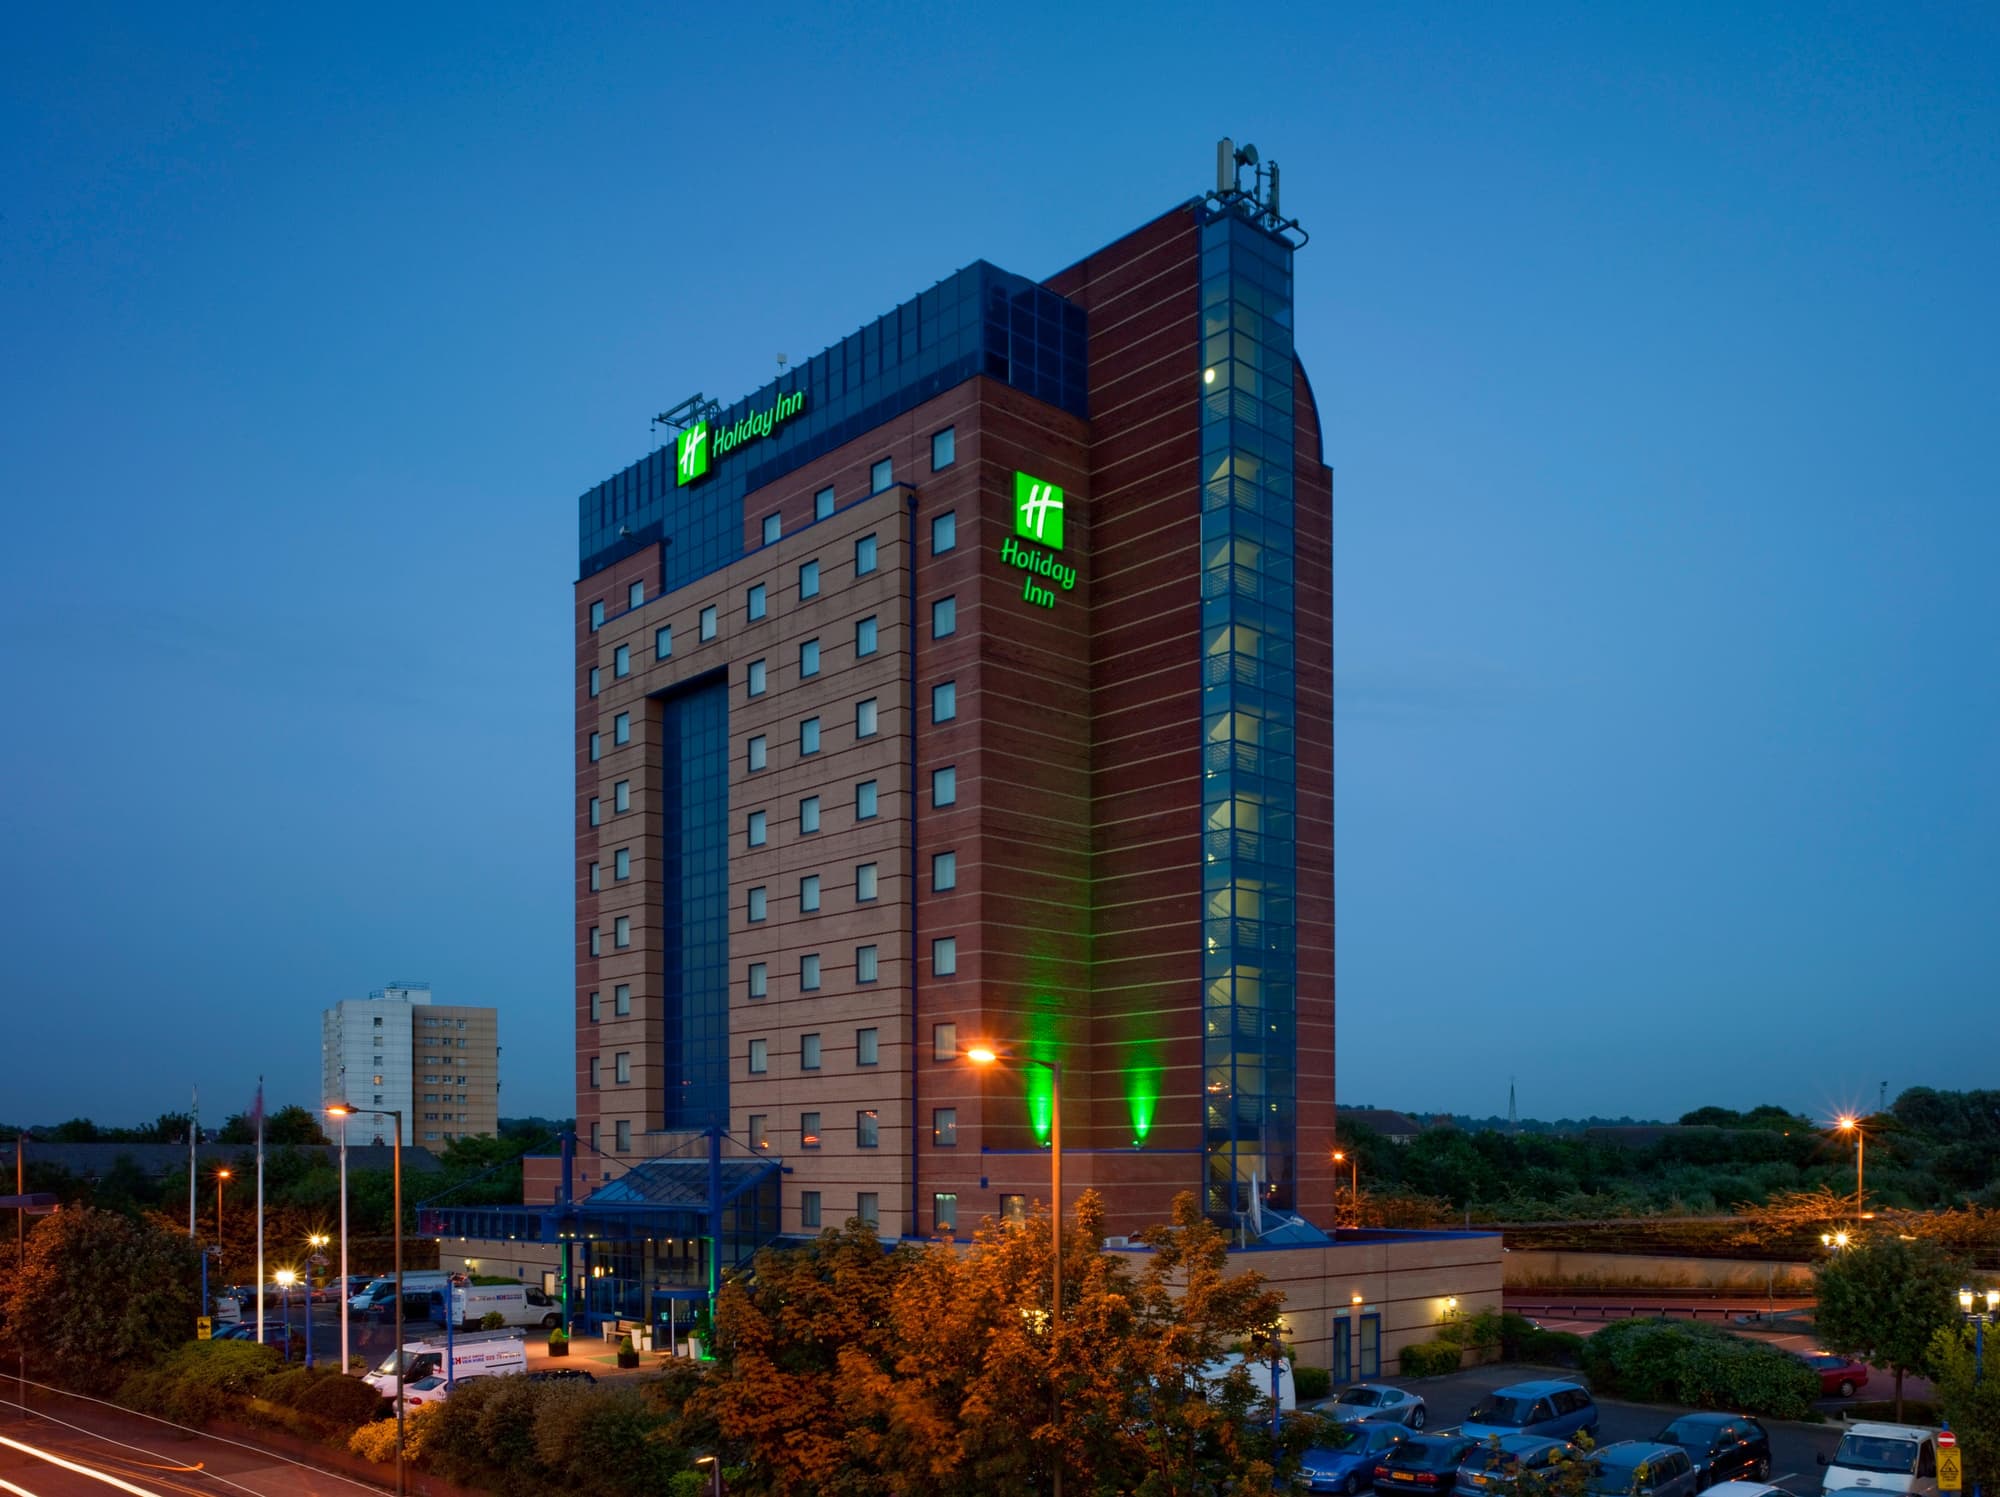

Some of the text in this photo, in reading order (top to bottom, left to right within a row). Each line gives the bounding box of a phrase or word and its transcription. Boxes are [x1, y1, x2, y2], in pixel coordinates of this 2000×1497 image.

[712, 391, 803, 459] Holiday Inn
[1001, 537, 1077, 590] Holiday
[1024, 575, 1055, 609] Inn
